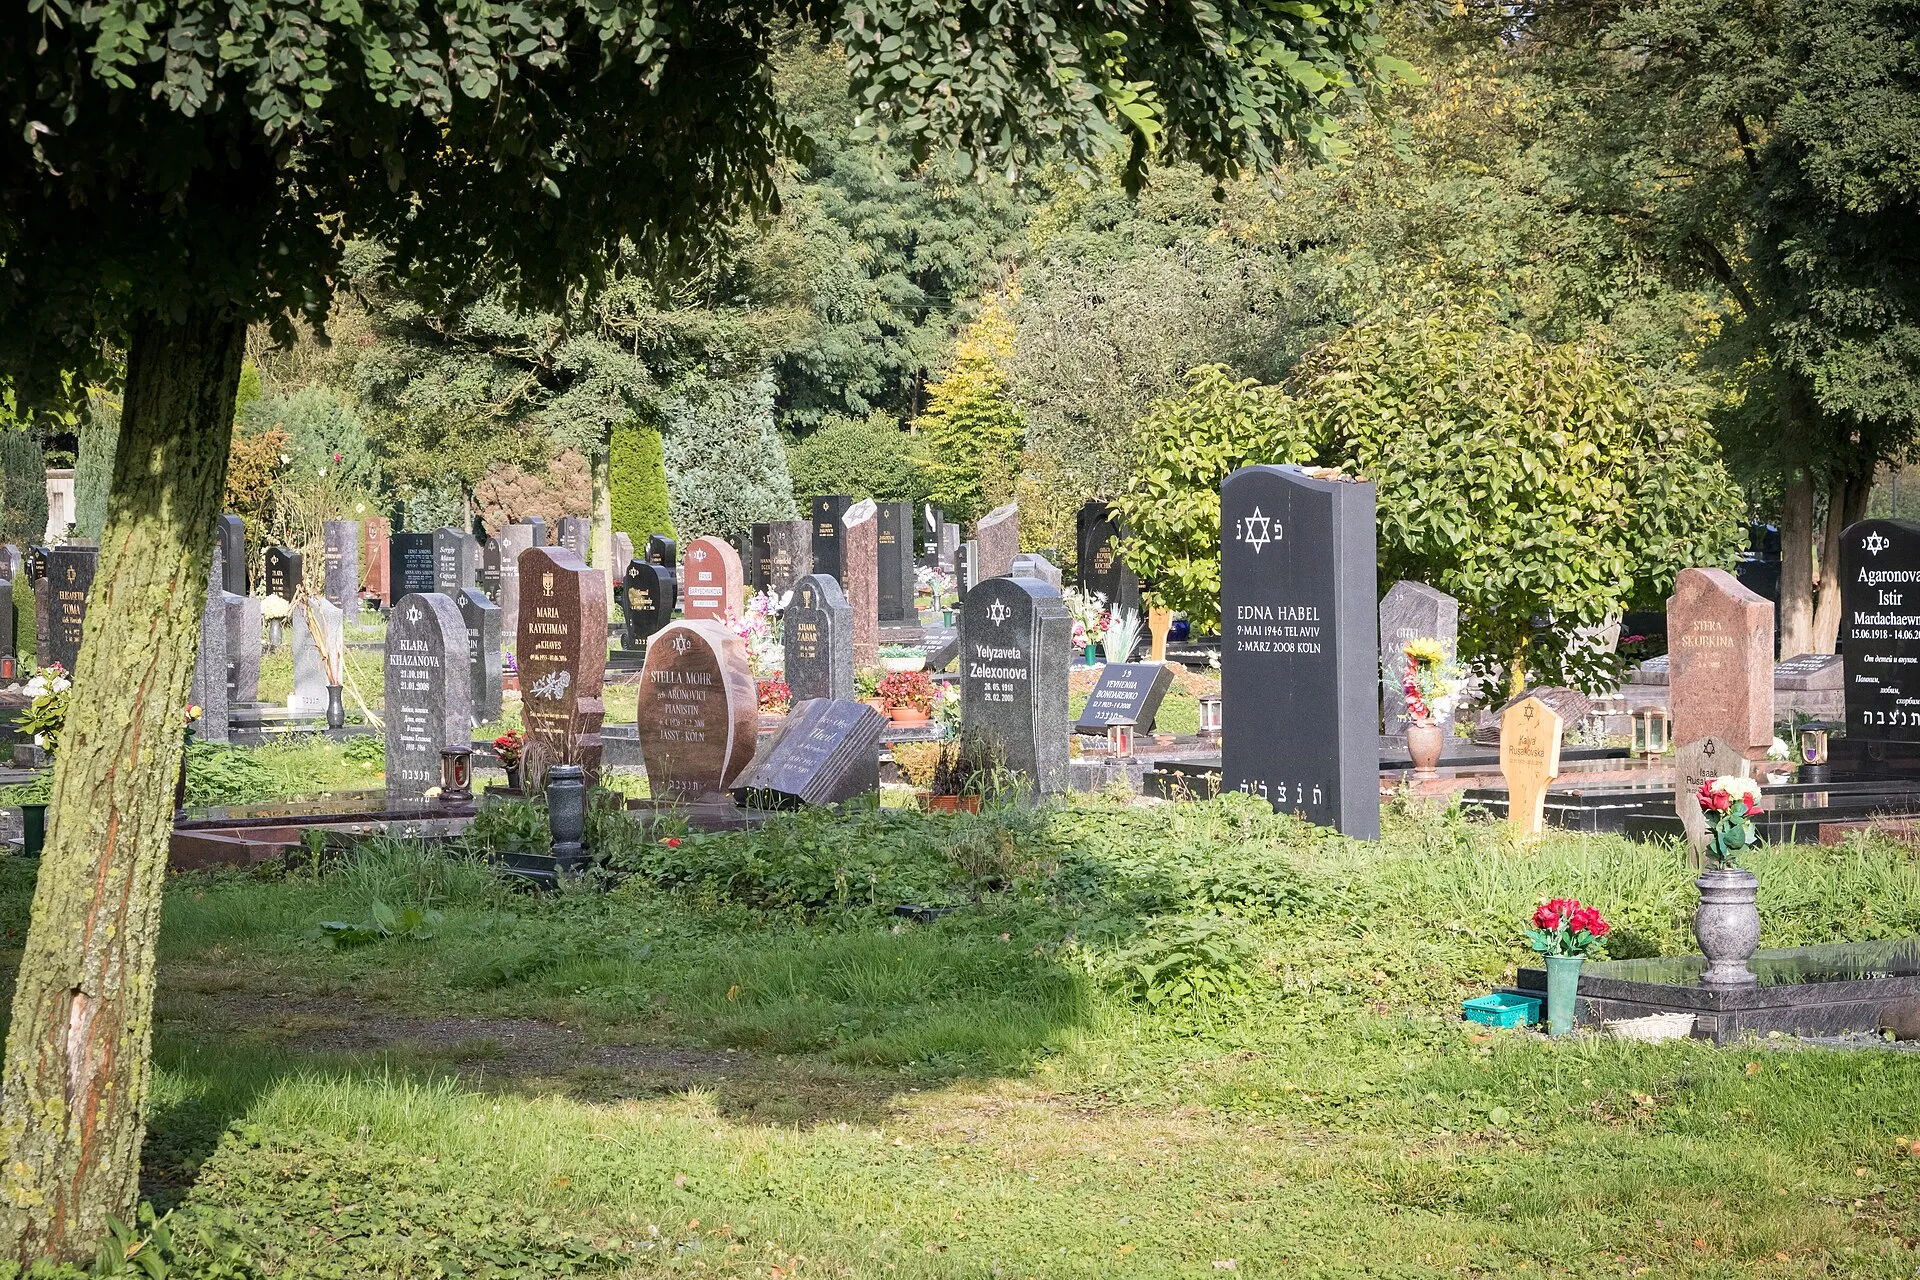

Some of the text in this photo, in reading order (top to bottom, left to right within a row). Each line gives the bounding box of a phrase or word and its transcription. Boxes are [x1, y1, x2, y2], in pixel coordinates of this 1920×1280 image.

[1858, 566, 1920, 586] Agaronova
[1878, 589, 1903, 606] Istir
[1237, 606, 1320, 621] EDNA HABEL
[528, 623, 568, 634] RAYKHMAN
[1264, 626, 1282, 636] 1946
[1284, 626, 1298, 637] TEL
[1299, 627, 1320, 637] AVIV
[1852, 629, 1888, 639] 15.06.1918
[400, 640, 428, 651] KLARA
[1273, 642, 1295, 652] 2008
[976, 645, 1021, 661] Yelyzaveta
[390, 655, 439, 667] KHAZANOVA
[970, 663, 1027, 680] Zelexonova
[651, 671, 712, 685] STELLA MOHR
[667, 690, 706, 701] ARONOVICI
[1096, 690, 1138, 700] BONDARENKO
[665, 703, 698, 715] PIANISTIN
[660, 730, 679, 741] JASSY
[685, 729, 704, 742] KÖLN
[1700, 768, 1718, 778] Isaak
